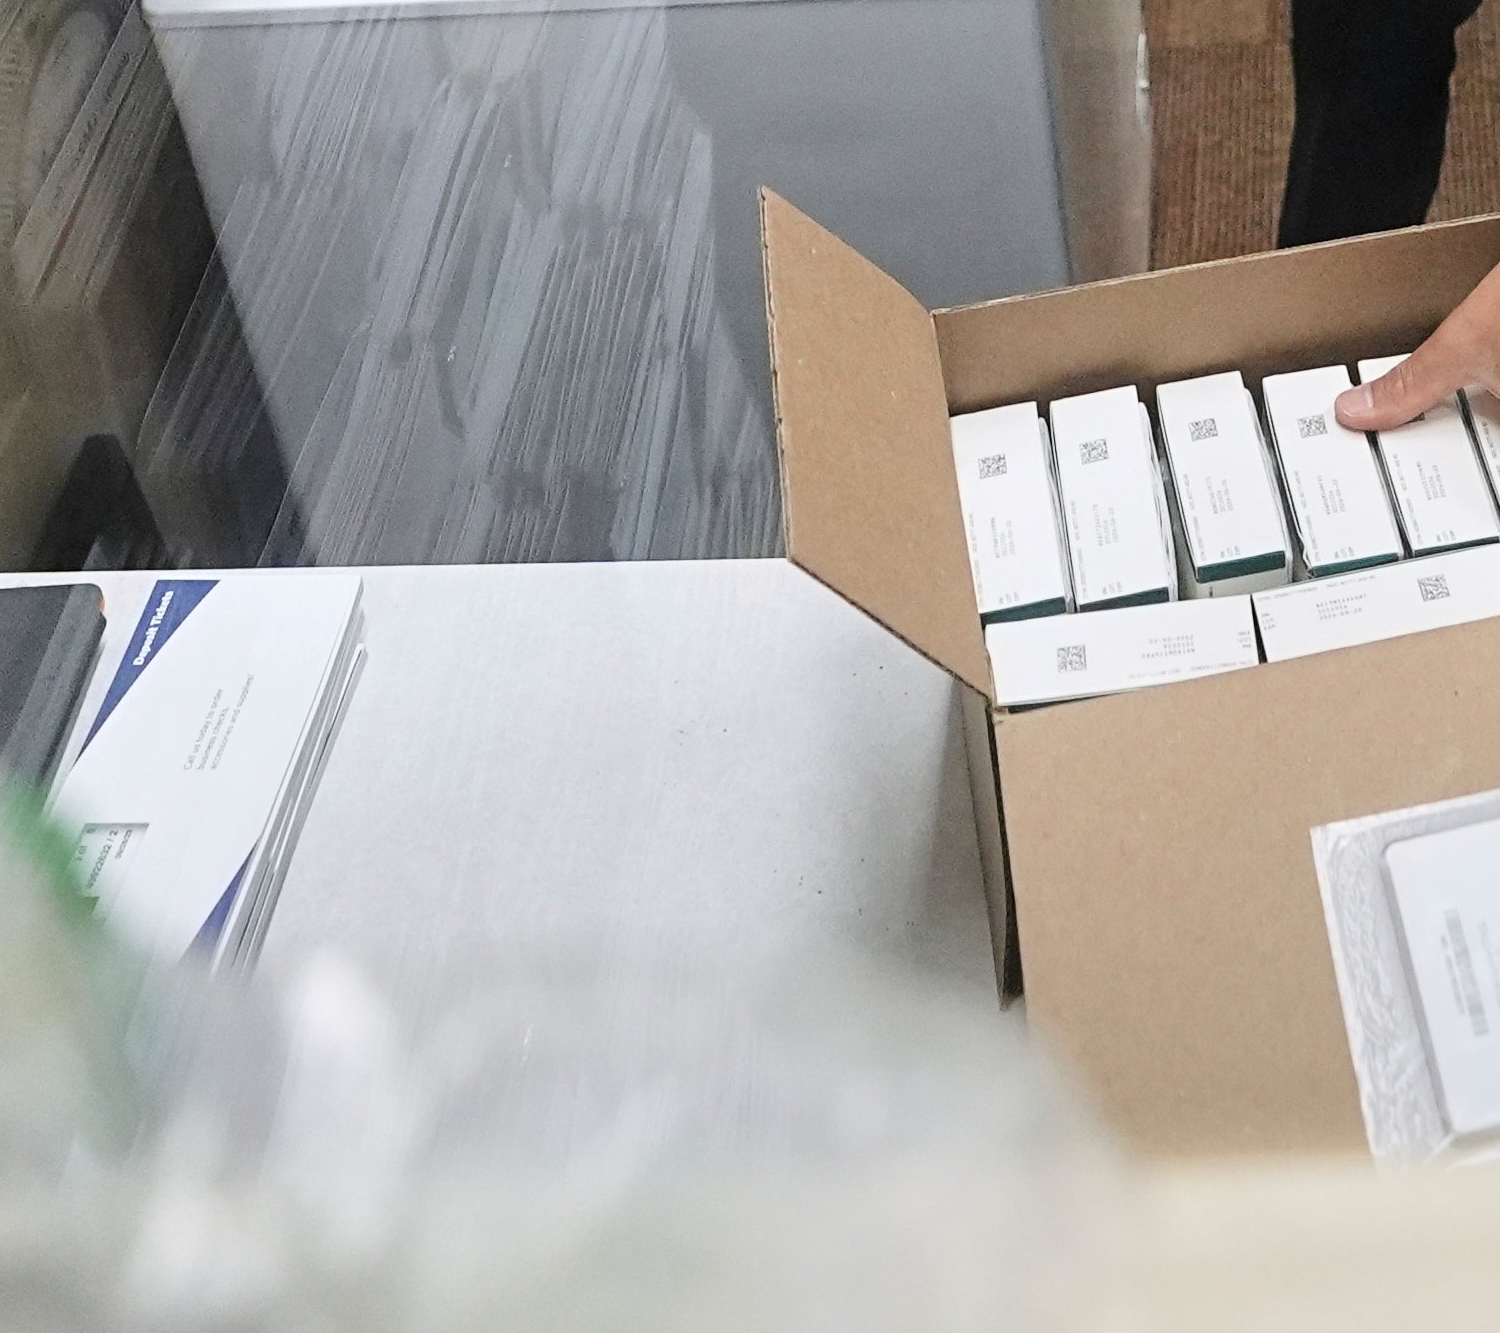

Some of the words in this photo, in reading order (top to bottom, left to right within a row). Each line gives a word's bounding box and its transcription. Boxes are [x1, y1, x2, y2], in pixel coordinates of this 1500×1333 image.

[133, 627, 159, 666] Deposit
[147, 589, 174, 626] Tickets
[184, 753, 197, 770] Call
[194, 720, 215, 743] today
[208, 687, 224, 710] order
[197, 735, 220, 771] business
[211, 724, 235, 770] accessories
[229, 707, 241, 724] and
